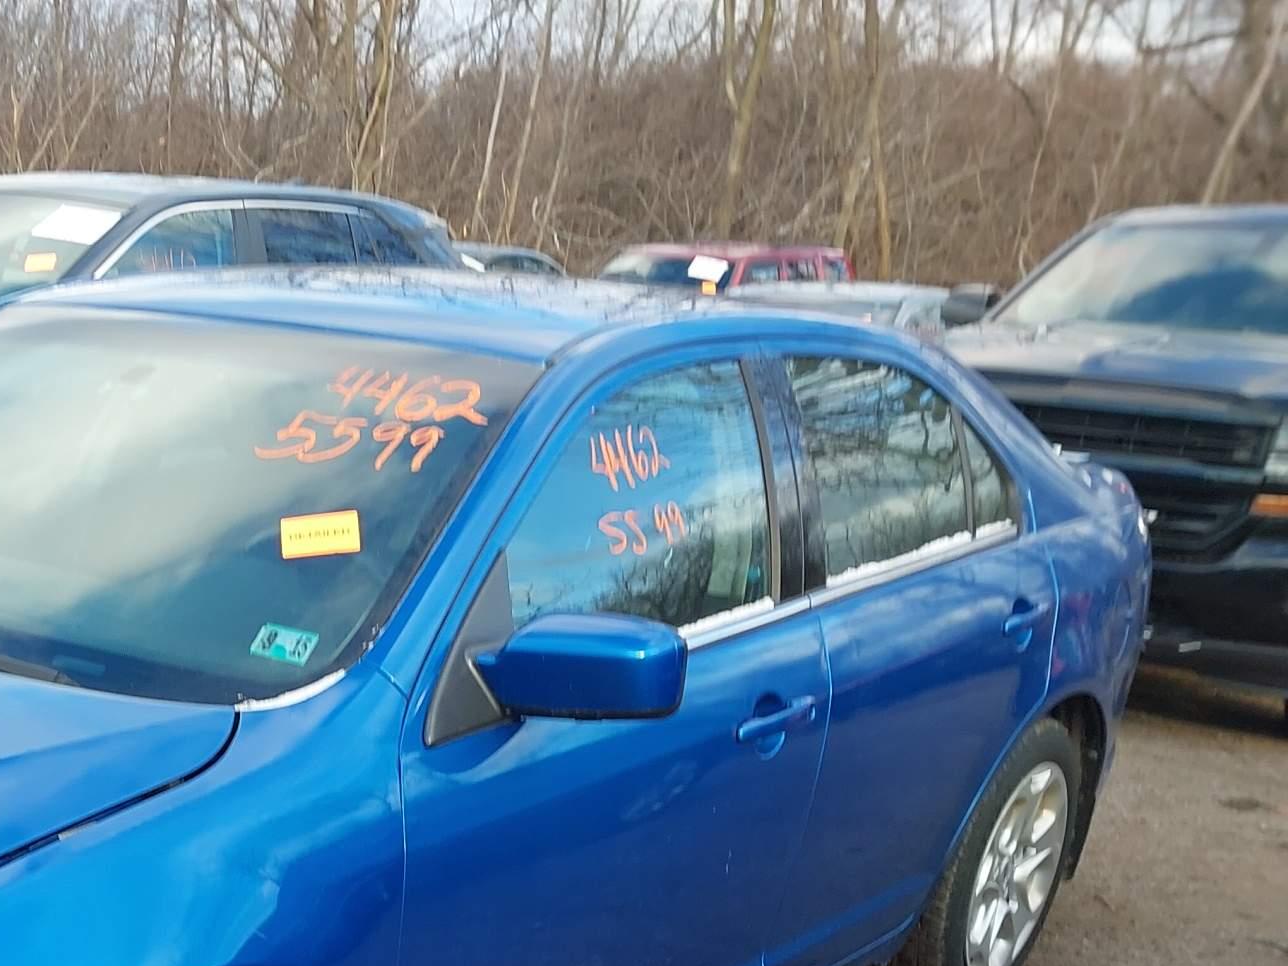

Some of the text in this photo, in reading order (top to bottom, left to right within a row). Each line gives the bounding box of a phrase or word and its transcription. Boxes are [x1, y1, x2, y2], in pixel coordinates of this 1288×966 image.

[327, 366, 488, 426] 4462
[254, 409, 445, 472] 5599
[591, 424, 670, 492] 4462
